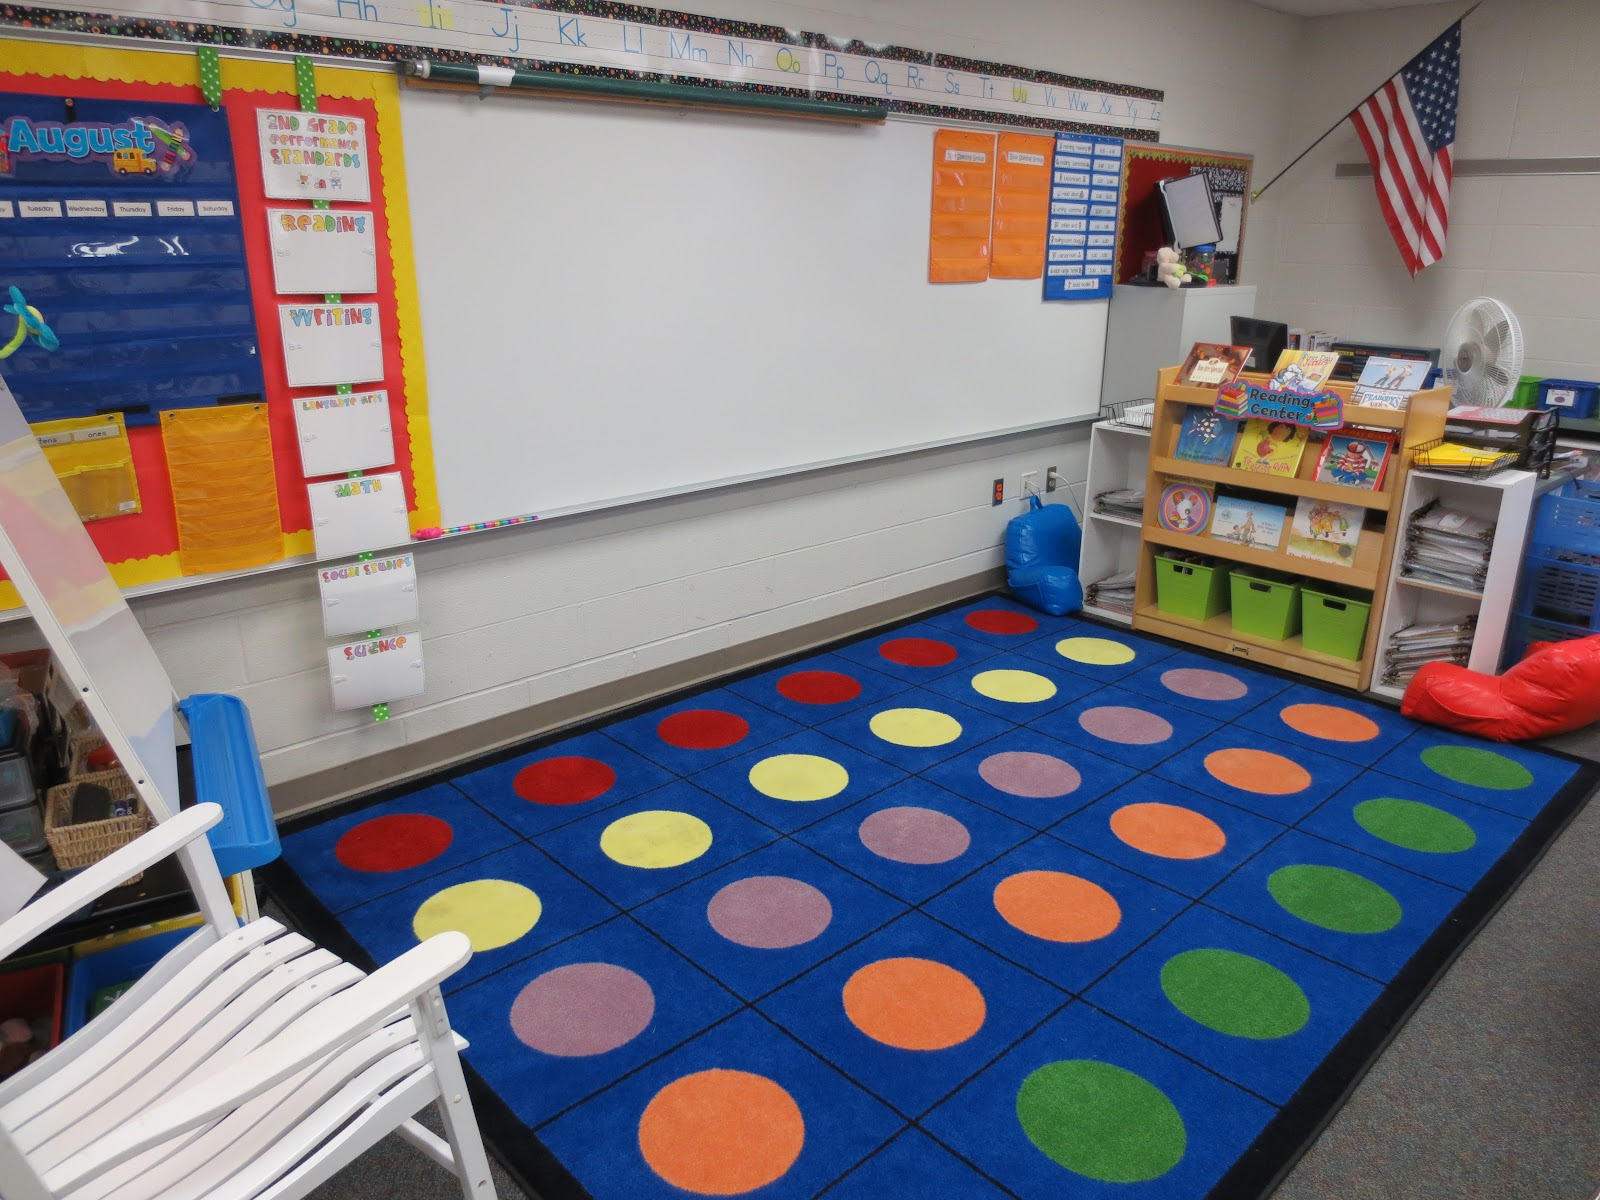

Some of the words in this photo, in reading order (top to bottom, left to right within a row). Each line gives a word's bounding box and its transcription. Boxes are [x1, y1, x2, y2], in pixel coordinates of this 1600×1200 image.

[251, 0, 297, 27] g
[492, 8, 520, 53] Jj
[557, 16, 588, 47] Kk
[622, 24, 643, 54] Ll
[669, 31, 708, 63] Mm
[728, 40, 754, 68] Nn
[776, 47, 801, 73] Oo
[824, 53, 845, 88] Pp
[865, 60, 892, 95] Qq
[907, 65, 925, 89] Rr
[944, 72, 960, 95] Ss
[979, 77, 995, 99] Tt
[1012, 81, 1027, 103] Uu
[1044, 86, 1057, 108] Vv
[1067, 90, 1089, 112] Ww
[1099, 95, 1112, 114] Xx
[1126, 99, 1138, 125] Yy
[1150, 102, 1161, 121] Zz
[267, 114, 300, 131] 2ND
[8, 119, 155, 158] August
[27, 205, 54, 213] Tuesday
[68, 205, 105, 213] Wednesday
[119, 206, 146, 214] Thursday
[203, 205, 228, 213] Saturday
[1319, 354, 1334, 363] Day
[1250, 388, 1312, 409] Reading
[1250, 404, 1304, 421] Center
[88, 430, 107, 438] ones
